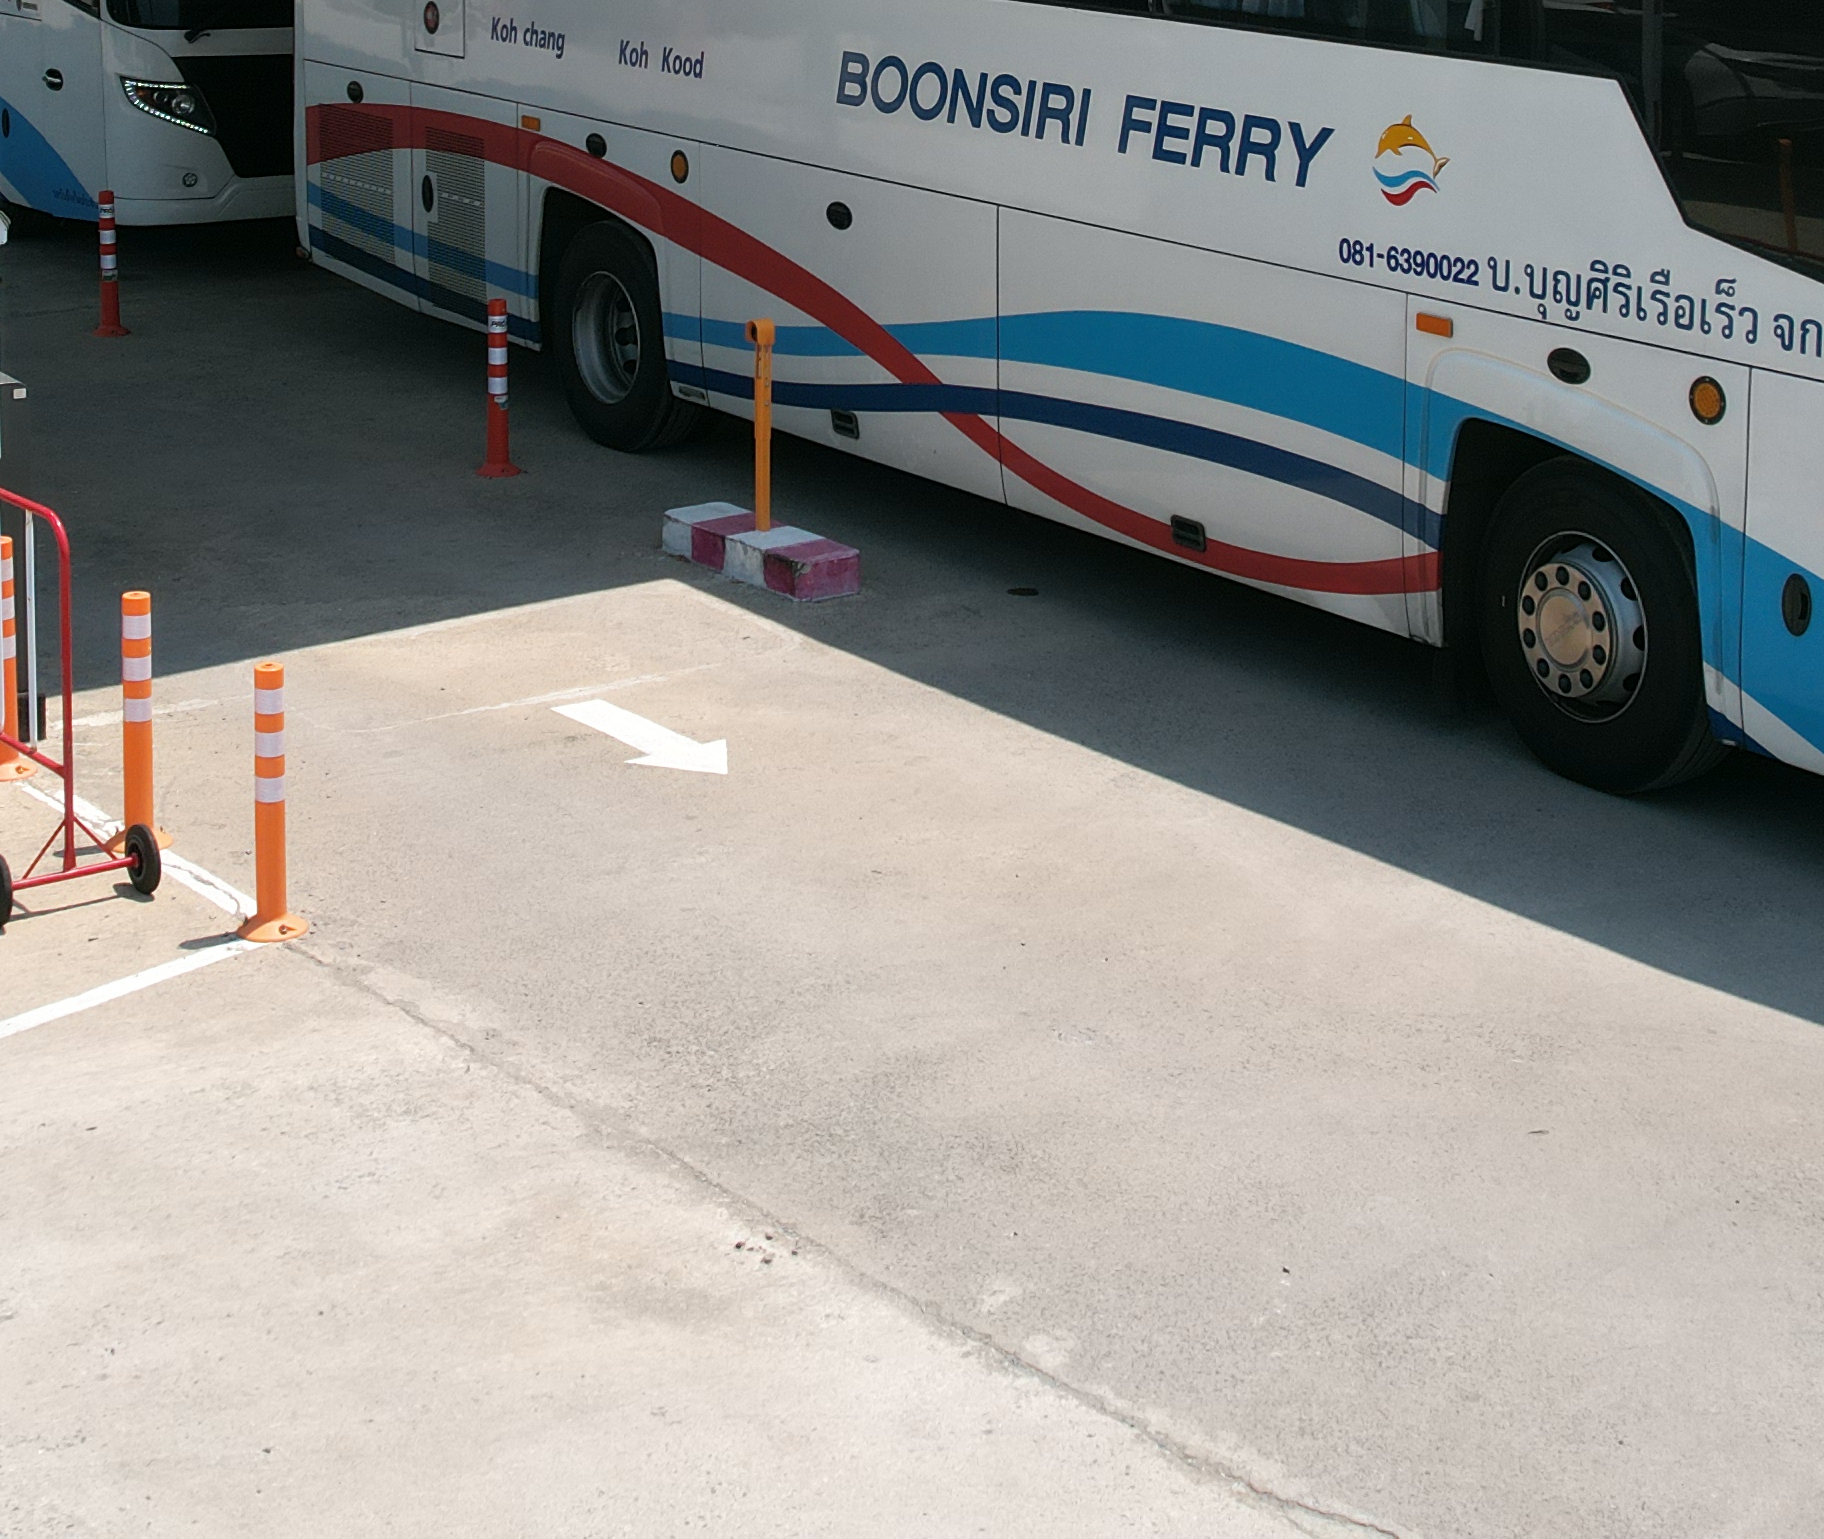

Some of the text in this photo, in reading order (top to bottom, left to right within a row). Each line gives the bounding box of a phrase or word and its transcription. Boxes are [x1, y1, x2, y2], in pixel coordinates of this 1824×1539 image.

[490, 16, 566, 59] Koh chang
[618, 39, 705, 79] Koh Kood
[836, 50, 1335, 188] BOONSIRI FERRY
[1338, 237, 1480, 287] 081-6390022
